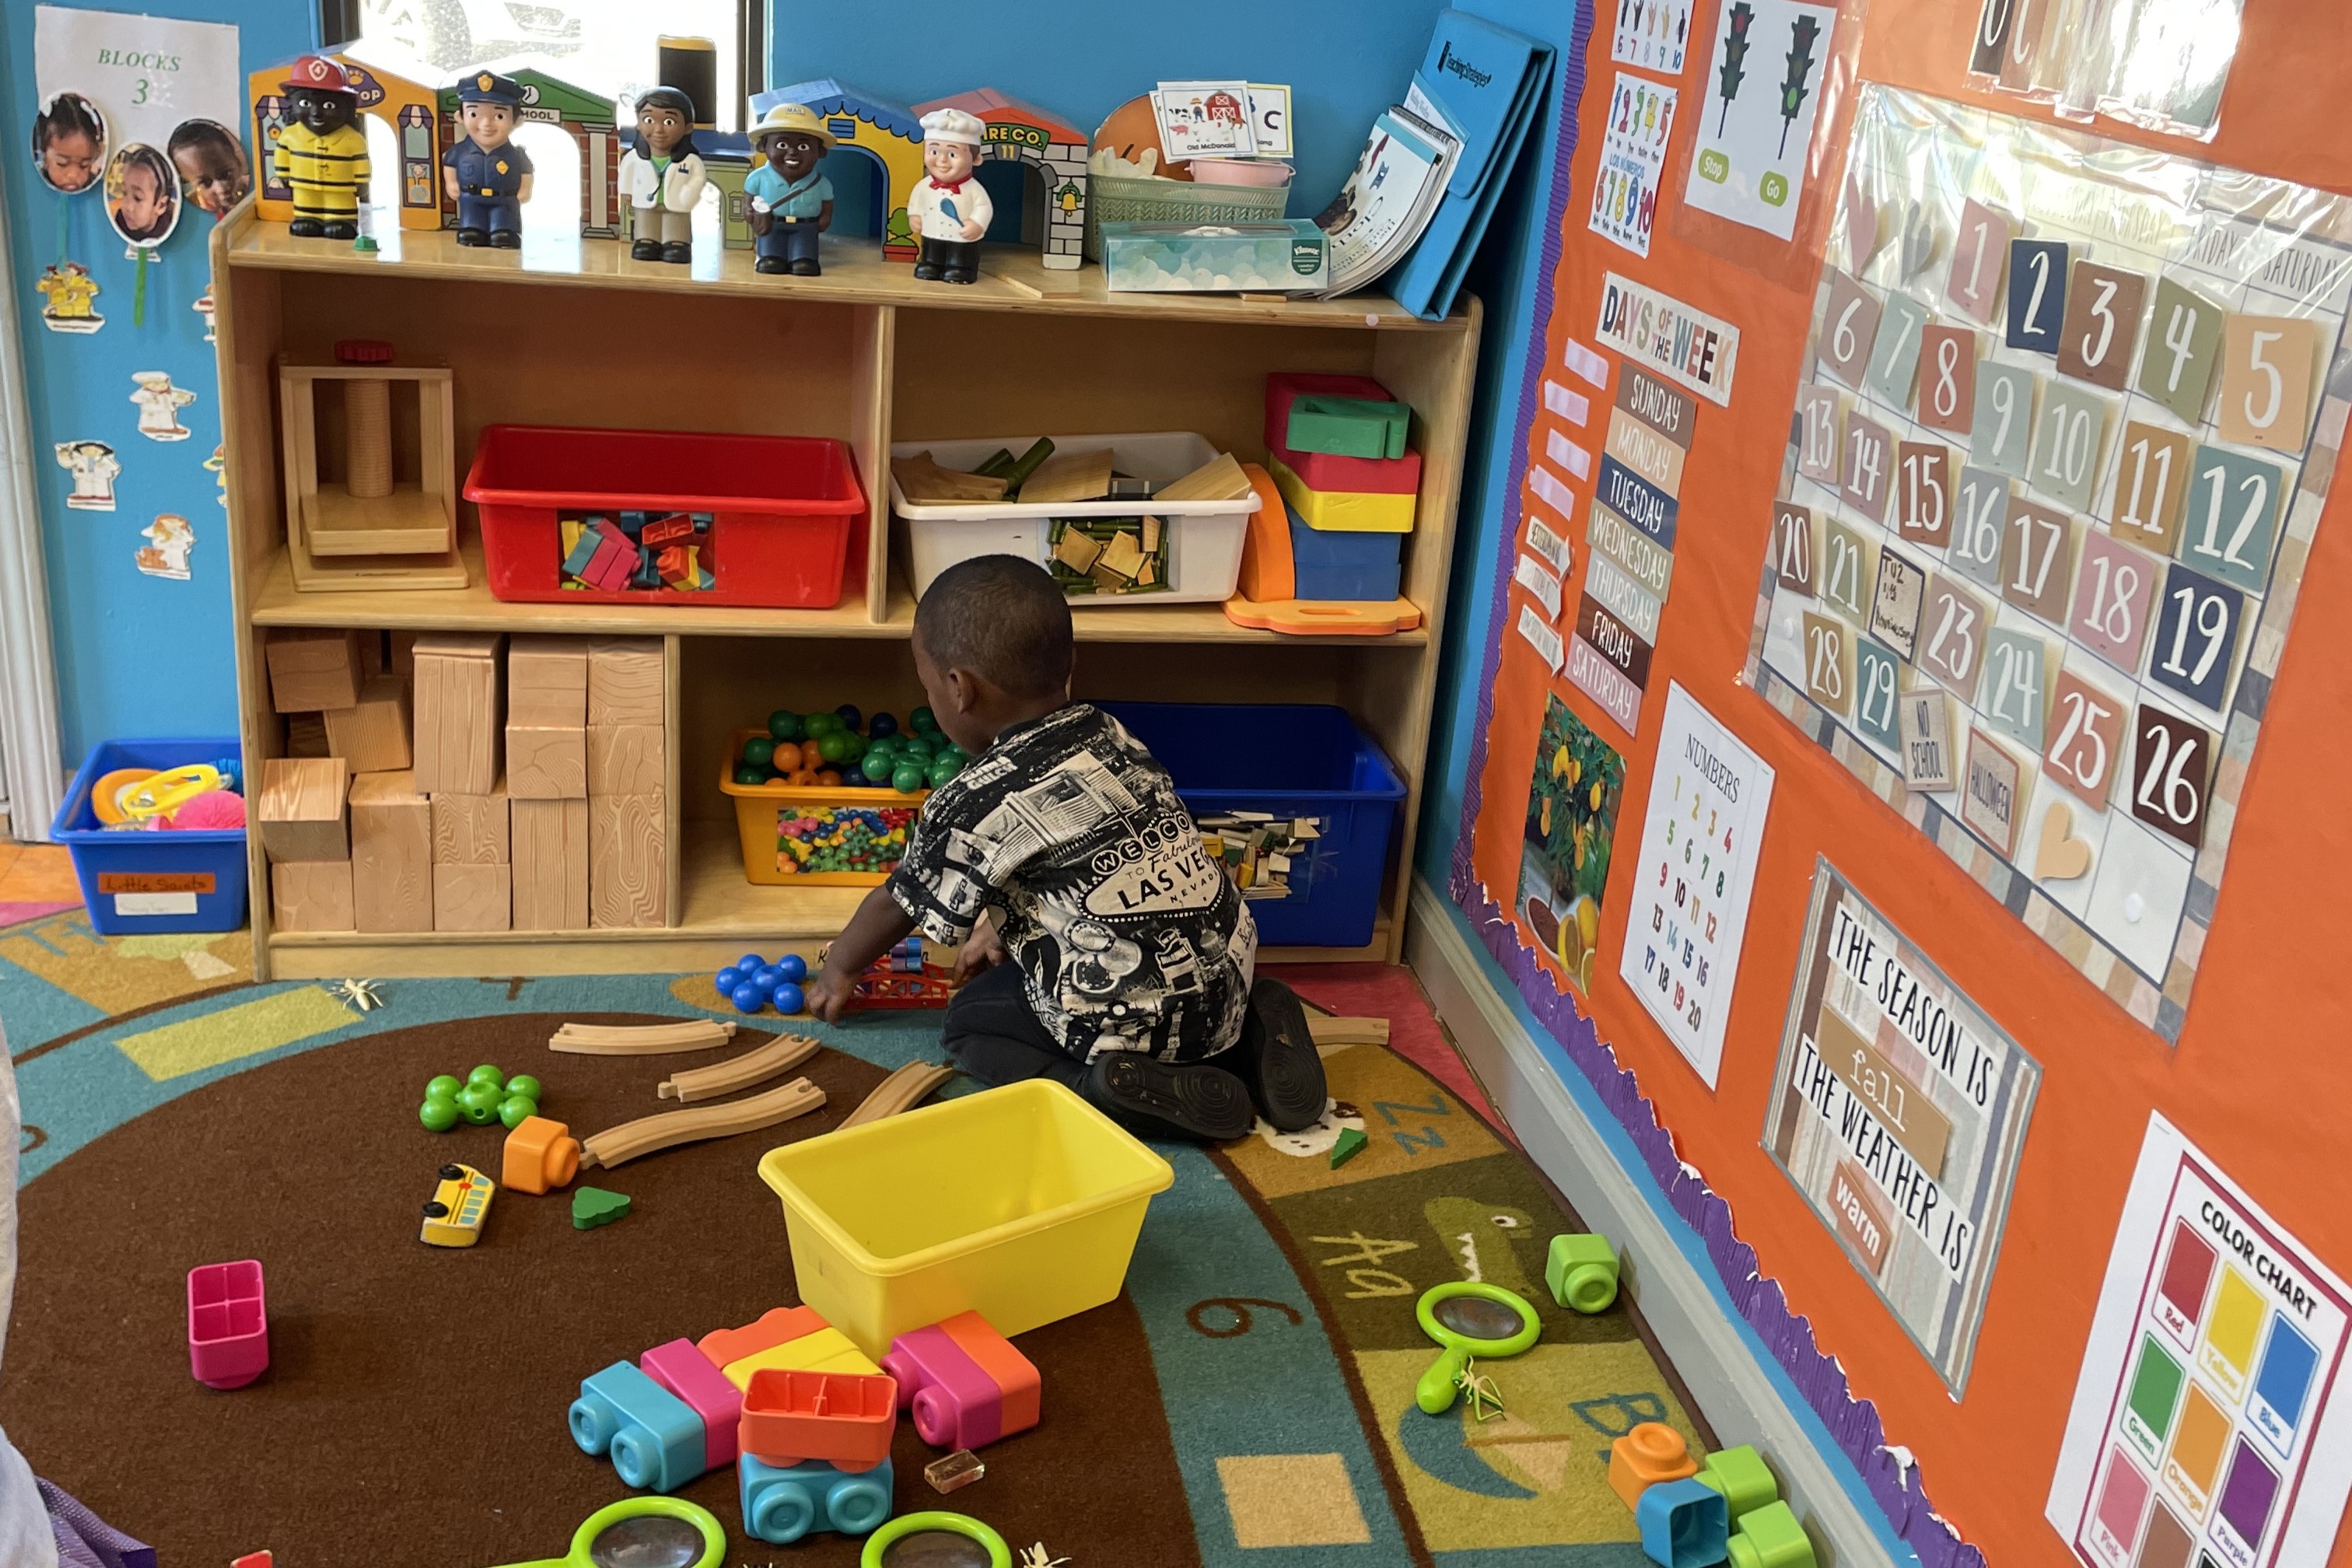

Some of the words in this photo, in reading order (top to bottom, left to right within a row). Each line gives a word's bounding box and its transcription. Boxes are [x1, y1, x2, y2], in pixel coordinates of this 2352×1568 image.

[98, 48, 181, 72] BLOCKS
[1618, 35, 1623, 53] 6
[1631, 38, 1636, 60] 7
[1644, 41, 1650, 62] 8
[1660, 46, 1666, 68] 9
[1672, 50, 1682, 69] 10
[131, 79, 149, 104] 3
[359, 89, 381, 100] OP
[521, 110, 555, 121] HOOL
[1264, 110, 1282, 130] C
[1618, 89, 1630, 133] 2
[1631, 85, 1645, 136] 3
[1656, 97, 1672, 146] 5
[983, 126, 1008, 141] IRE
[1012, 130, 1043, 147] CO.
[1002, 145, 1014, 159] 11
[1187, 142, 1199, 151] Old
[1704, 156, 1723, 180] Stop
[1766, 179, 1780, 199] Go
[1596, 166, 1608, 212] 6
[1605, 170, 1617, 215] 7
[1615, 172, 1627, 222] 8
[1626, 177, 1639, 226] 9
[1637, 187, 1653, 233] 10
[2187, 224, 2239, 269] FRIDAY
[2263, 247, 2340, 300] SATURDAY
[1603, 284, 1653, 350] DAYS
[1651, 332, 1671, 362] THE
[1657, 308, 1674, 332] OF
[1964, 222, 1987, 299] 1
[2022, 250, 2049, 334] 2
[2082, 279, 2118, 366] 3
[2166, 305, 2196, 391] 4
[2245, 331, 2283, 426] 5
[1672, 312, 1733, 393] WEEK
[1631, 373, 1682, 432] SUNDAY
[1617, 422, 1671, 484] MONDAY
[1834, 299, 1861, 362] 6
[1884, 309, 1914, 379] 7
[1934, 339, 1958, 415] 8
[1992, 376, 2012, 455] 9
[2045, 403, 2090, 485] 10
[2121, 438, 2172, 534] 11
[2194, 466, 2266, 569] 12
[1609, 467, 1666, 534] TUESDAY
[1592, 509, 1668, 591] WEDNESDAY
[1806, 398, 1833, 468] 13
[1849, 428, 1880, 502] 14
[1903, 454, 1943, 530] 15
[1955, 480, 1998, 564] 16
[2012, 514, 2062, 599] 17
[2084, 557, 2139, 643] 18
[2162, 586, 2230, 686] 19
[1594, 558, 1654, 633] THURSDAY
[1591, 609, 1633, 670] FRIDAY
[1781, 513, 1809, 583] 20
[1829, 534, 1860, 614] 21
[1929, 593, 1975, 681] 23
[1993, 642, 2037, 725] 24
[2050, 691, 2111, 788] 25
[2137, 723, 2200, 825] 26
[1572, 644, 1633, 721] SATURDAY
[1810, 625, 1842, 698] 28
[1863, 654, 1895, 730] 29
[1685, 733, 1740, 804] NUMBERS
[1094, 814, 1190, 872] WELCO
[1674, 775, 1682, 801] 1
[1692, 793, 1700, 821] 2
[1709, 809, 1717, 836] 3
[1724, 828, 1733, 854] 4
[1125, 867, 1144, 880] TO
[1667, 819, 1675, 845] 5
[1685, 838, 1693, 864] 6
[1702, 854, 1710, 880] 7
[1717, 871, 1725, 898] 8
[1117, 869, 1175, 910] LAS
[1660, 863, 1668, 887] 9
[1675, 878, 1685, 908] 10
[1690, 894, 1700, 925] 11
[1705, 912, 1717, 943] 12
[1653, 903, 1664, 932] 13
[1667, 919, 1678, 951] 14
[1682, 937, 1694, 969] 15
[1696, 954, 1709, 988] 16
[1645, 945, 1656, 975] 17
[1658, 961, 1669, 992] 18
[1672, 979, 1684, 1011] 19
[1687, 999, 1701, 1032] 20
[1834, 909, 1874, 986] THE
[1878, 959, 1962, 1079] SEASON
[1970, 1045, 1993, 1107] IS
[1852, 1051, 1908, 1133] fall
[1801, 1042, 1833, 1119] THE
[1841, 1103, 1936, 1240] WEATHER
[1942, 1209, 1969, 1273] IS
[1836, 1174, 1881, 1258] warm
[2201, 1200, 2254, 1267] COLOR
[2256, 1253, 2318, 1321] CHART
[2165, 1307, 2184, 1334] Red
[2206, 1349, 2238, 1390] Yellow
[2129, 1417, 2154, 1456] Green
[2259, 1407, 2281, 1439] Blue
[2168, 1463, 2204, 1512] Orange
[2101, 1530, 2119, 1561] Pink
[2217, 1525, 2249, 1566] Purple
